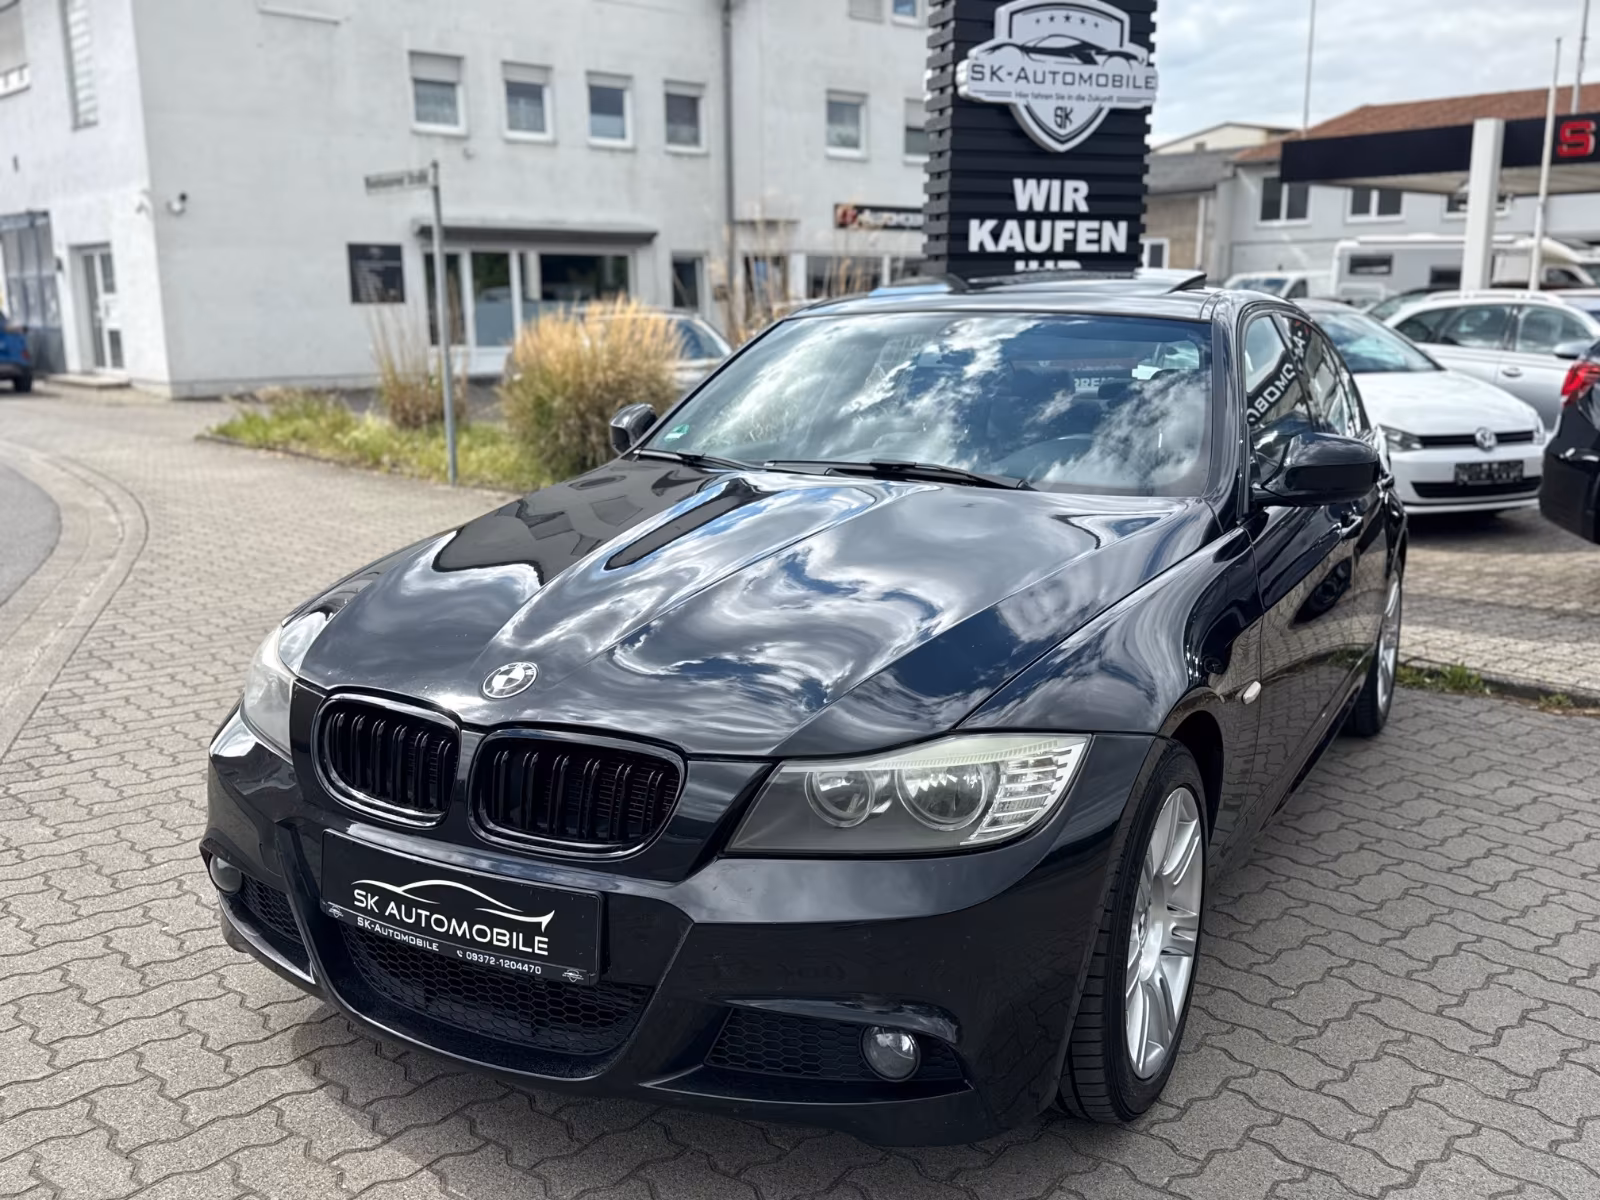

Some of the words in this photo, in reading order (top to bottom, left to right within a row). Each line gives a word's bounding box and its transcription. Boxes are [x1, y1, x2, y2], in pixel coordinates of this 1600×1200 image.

[970, 64, 1156, 90] SK-AUTOMOBILE
[1054, 106, 1074, 130] SK
[1557, 120, 1596, 158] S
[1012, 178, 1089, 212] WIR
[968, 219, 1128, 253] KAUFEN
[354, 889, 379, 913] SK
[385, 901, 549, 956] AUTOMOBILE
[357, 916, 439, 951] SK-AUTOMOBILE
[466, 951, 542, 974] 09372-1204470
